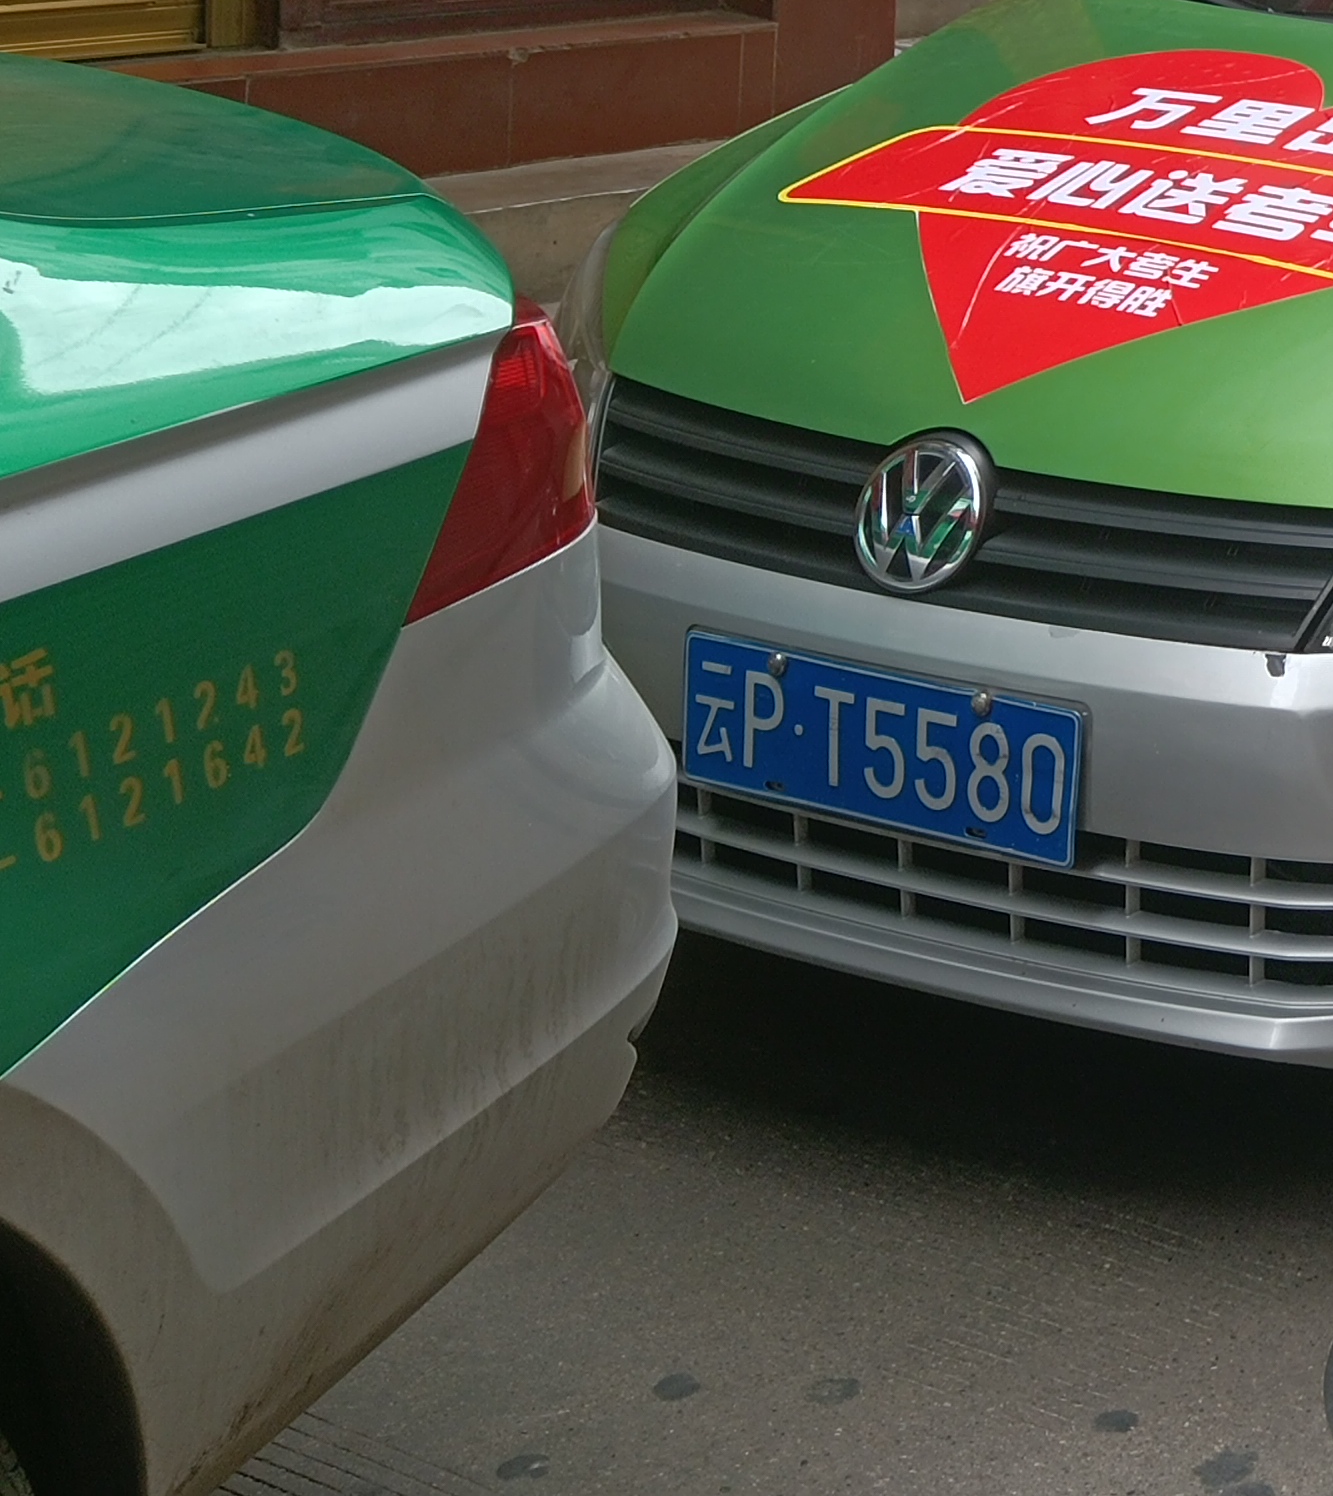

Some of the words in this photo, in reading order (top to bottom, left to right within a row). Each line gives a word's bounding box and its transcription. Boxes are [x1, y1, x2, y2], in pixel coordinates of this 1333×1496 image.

[1003, 232, 1219, 290] 祝广大考生
[994, 265, 1173, 319] 旗开得胜
[0, 649, 298, 801] 6121243
